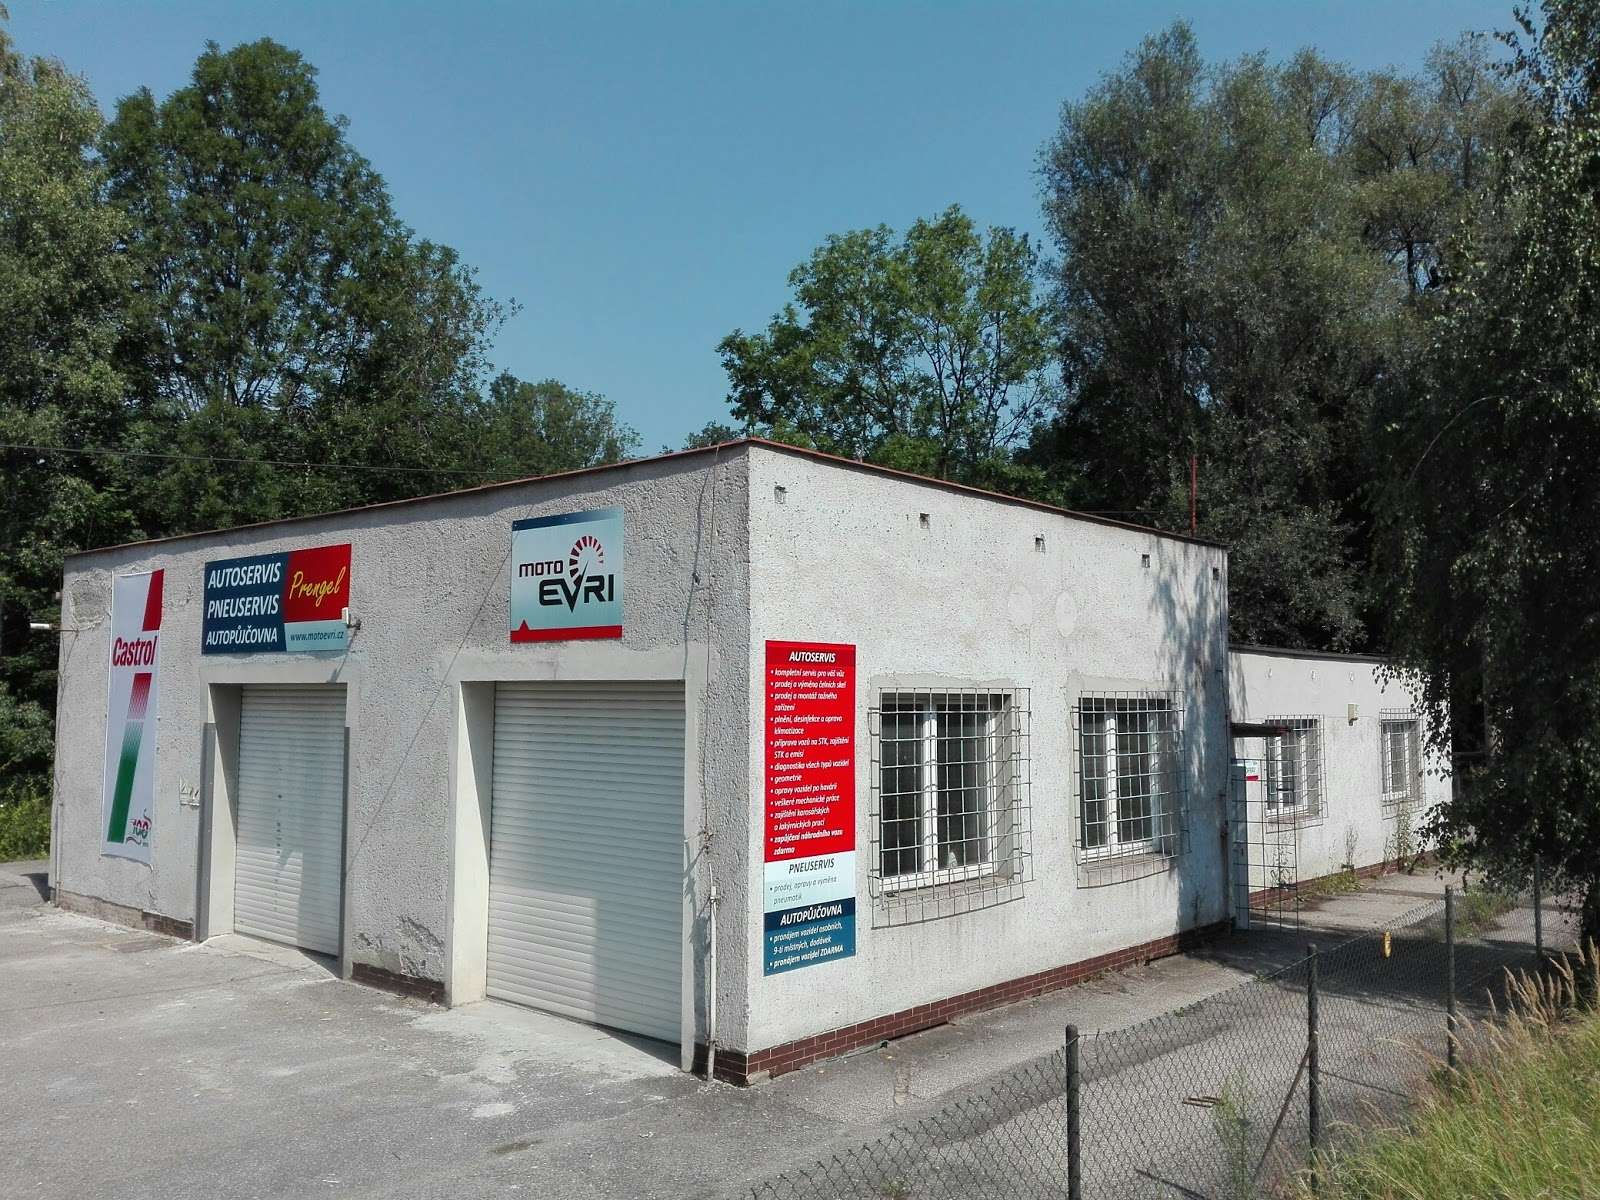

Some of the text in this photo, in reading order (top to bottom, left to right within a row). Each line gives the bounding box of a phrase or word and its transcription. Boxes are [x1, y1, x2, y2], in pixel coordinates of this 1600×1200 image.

[208, 562, 281, 589] AUTOSERVIS
[519, 560, 563, 577] MOTO
[289, 565, 346, 607] Prengel
[539, 573, 614, 613] EVRI
[207, 594, 279, 619] PNEUSERVIS
[206, 625, 277, 646] AUTOPŮJČOVNA
[290, 631, 343, 641] www.motoevri.cz
[113, 636, 157, 666] Castrol
[789, 651, 836, 663] AUTOSERVIS
[775, 680, 792, 688] prodej
[775, 692, 792, 701] prodej
[775, 788, 793, 796] opravy
[794, 785, 812, 793] vozidel
[774, 847, 795, 855] zdarma
[789, 858, 834, 874] PNEUSERVIS
[780, 904, 842, 926] AUTOPŮJČOVNA
[774, 930, 799, 943] pronájem
[801, 926, 819, 935] vozidel
[810, 936, 831, 946] dodávek
[774, 945, 843, 968] pronájem vozidel ZDARMA
